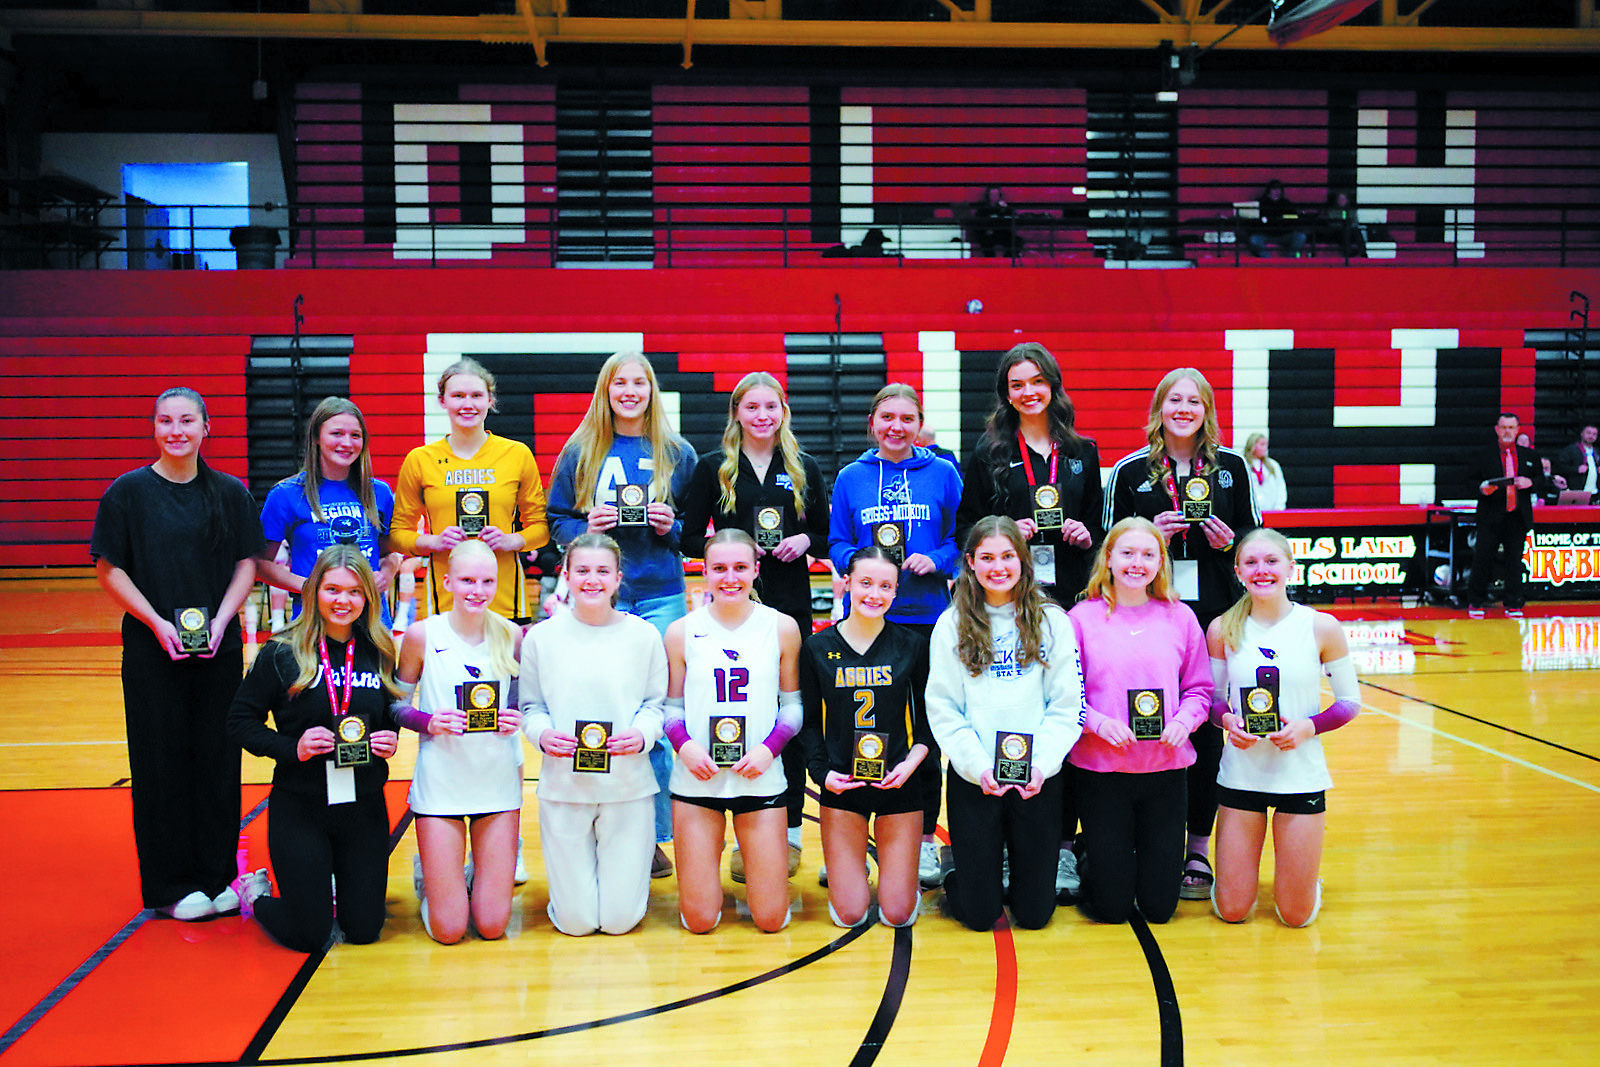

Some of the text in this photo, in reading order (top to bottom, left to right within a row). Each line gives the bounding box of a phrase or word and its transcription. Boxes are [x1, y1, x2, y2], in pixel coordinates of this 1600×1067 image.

[1357, 109, 1485, 258] H
[445, 469, 496, 485] AGGIES
[1340, 536, 1417, 558] LAKE
[1536, 533, 1571, 546] HOME
[1572, 533, 1590, 545] OF
[1308, 562, 1406, 586] SCHOOL
[713, 667, 750, 702] 12
[835, 665, 893, 688] AGGIES
[853, 688, 876, 729] 2
